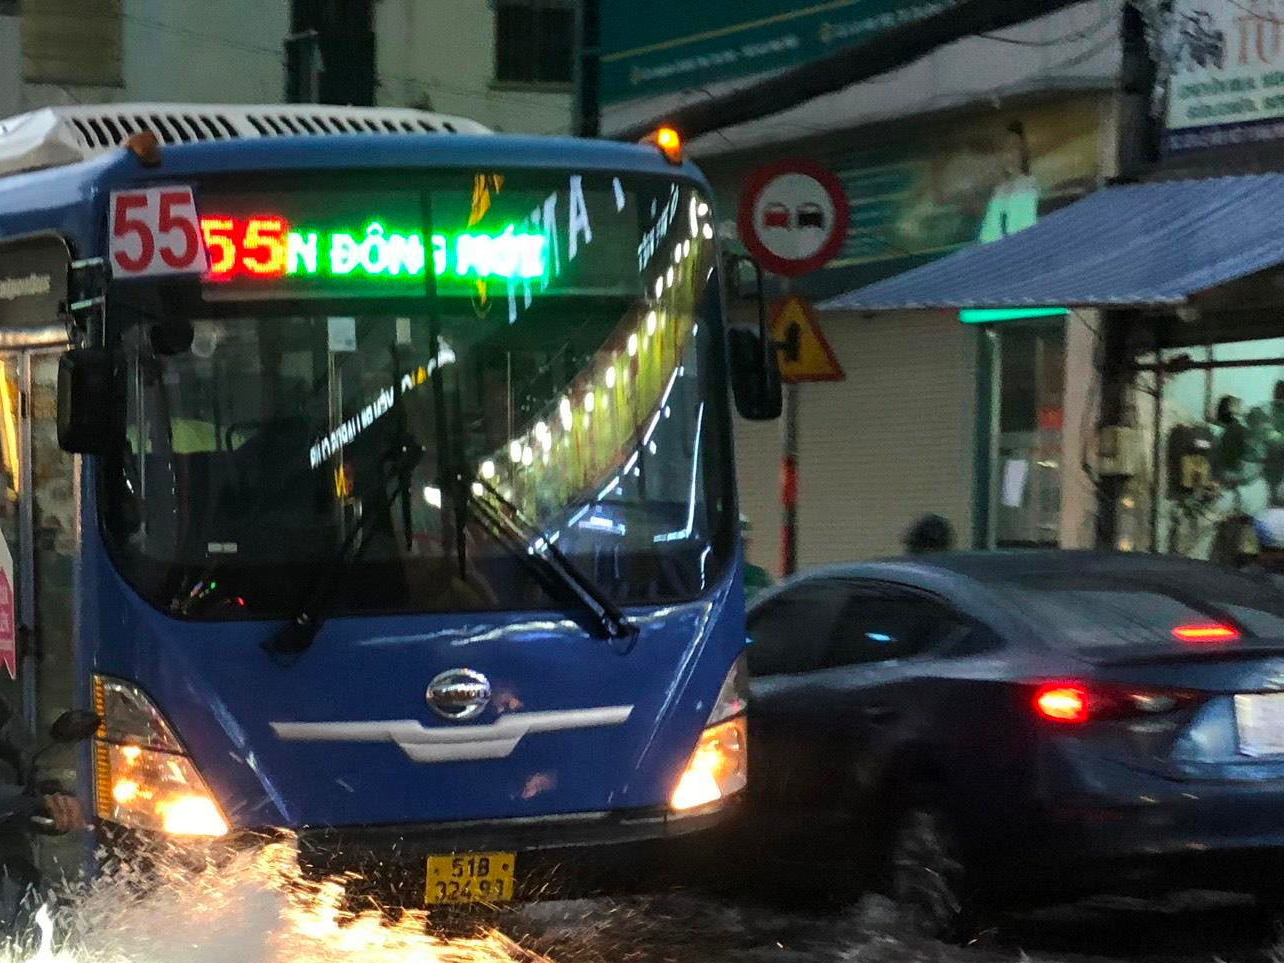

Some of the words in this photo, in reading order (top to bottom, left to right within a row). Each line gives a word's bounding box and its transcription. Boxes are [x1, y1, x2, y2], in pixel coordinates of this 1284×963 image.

[113, 191, 200, 272] 55
[201, 219, 286, 274] 55
[451, 857, 491, 878] 51B
